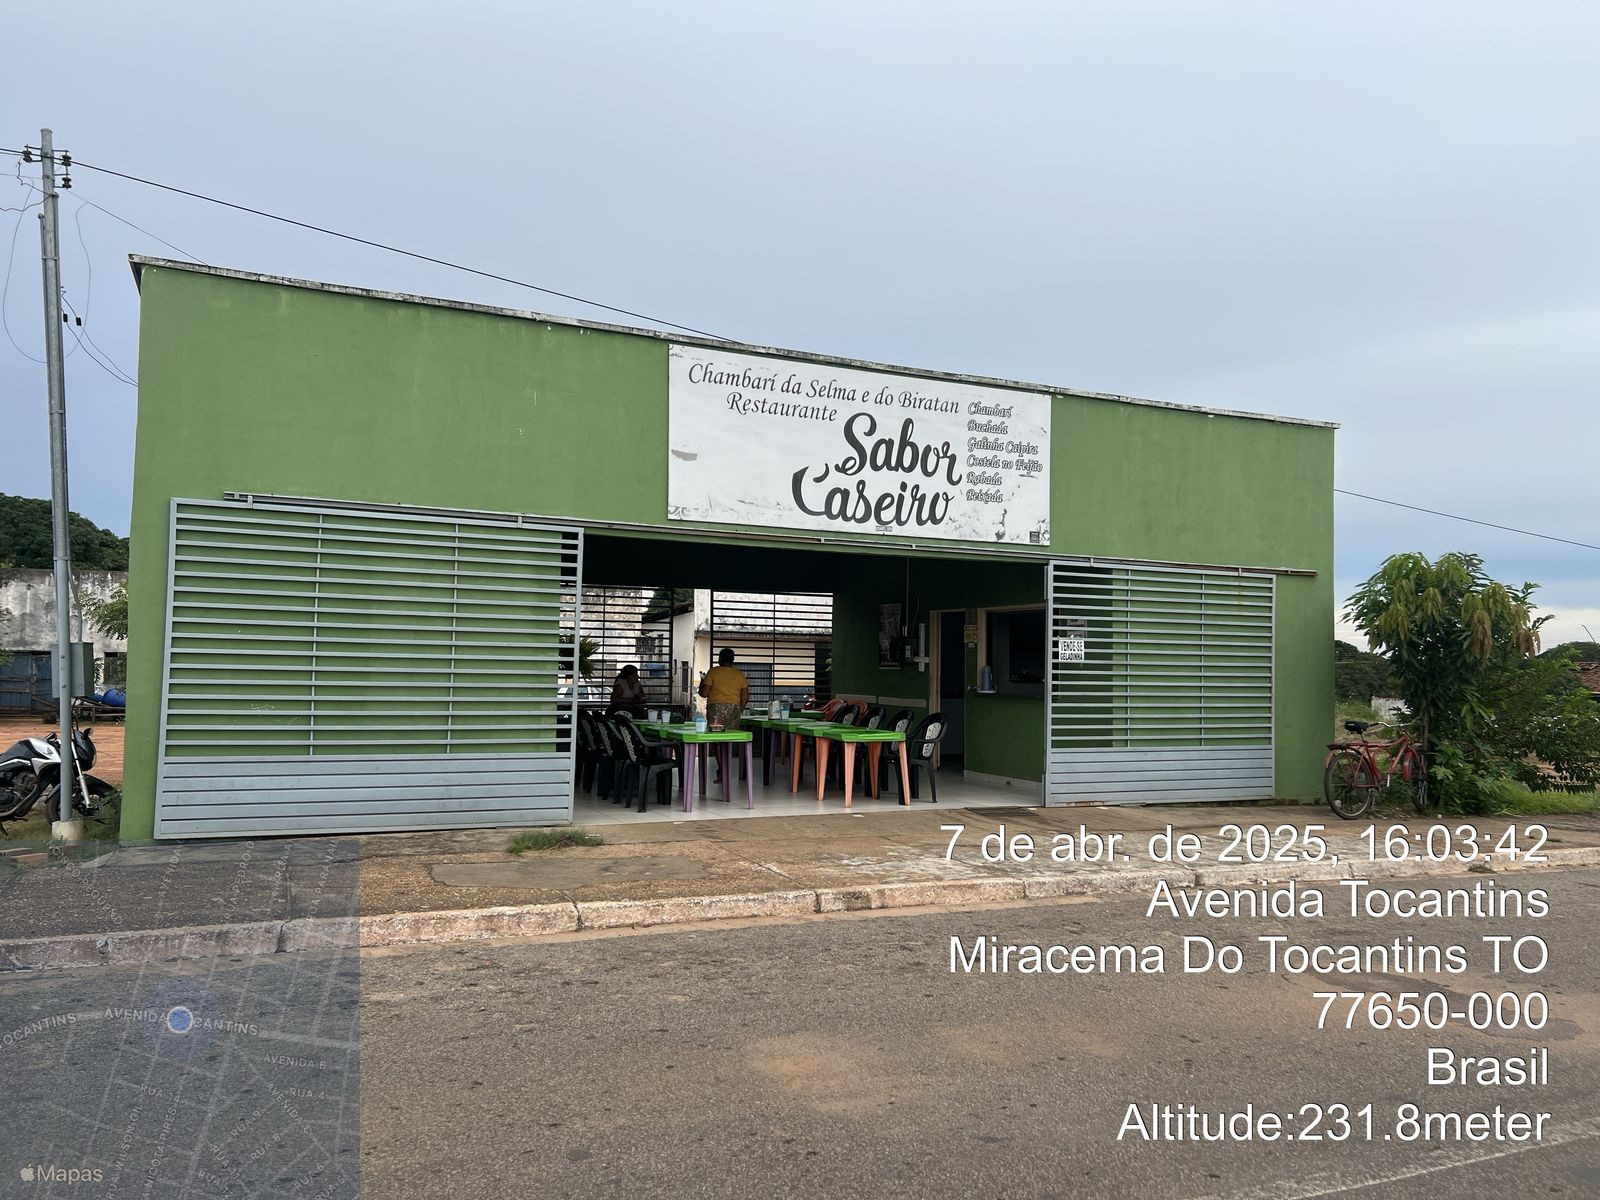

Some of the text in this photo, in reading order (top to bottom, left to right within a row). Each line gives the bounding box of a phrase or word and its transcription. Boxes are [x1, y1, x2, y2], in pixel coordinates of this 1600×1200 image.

[688, 362, 960, 414] Chambarí da Selma e do Biratan
[726, 391, 838, 422] Restaurante
[967, 419, 1008, 435] Buchada
[834, 412, 963, 487] Sabor
[967, 436, 1039, 457] Galinha Caipira
[966, 454, 1044, 475] Costela no Feijão
[966, 471, 1003, 487] Rabada
[791, 463, 955, 527] Caseiro
[966, 489, 1004, 505] Peixada
[1060, 641, 1083, 651] VENDE-SE
[1060, 652, 1083, 661] GELADINHA
